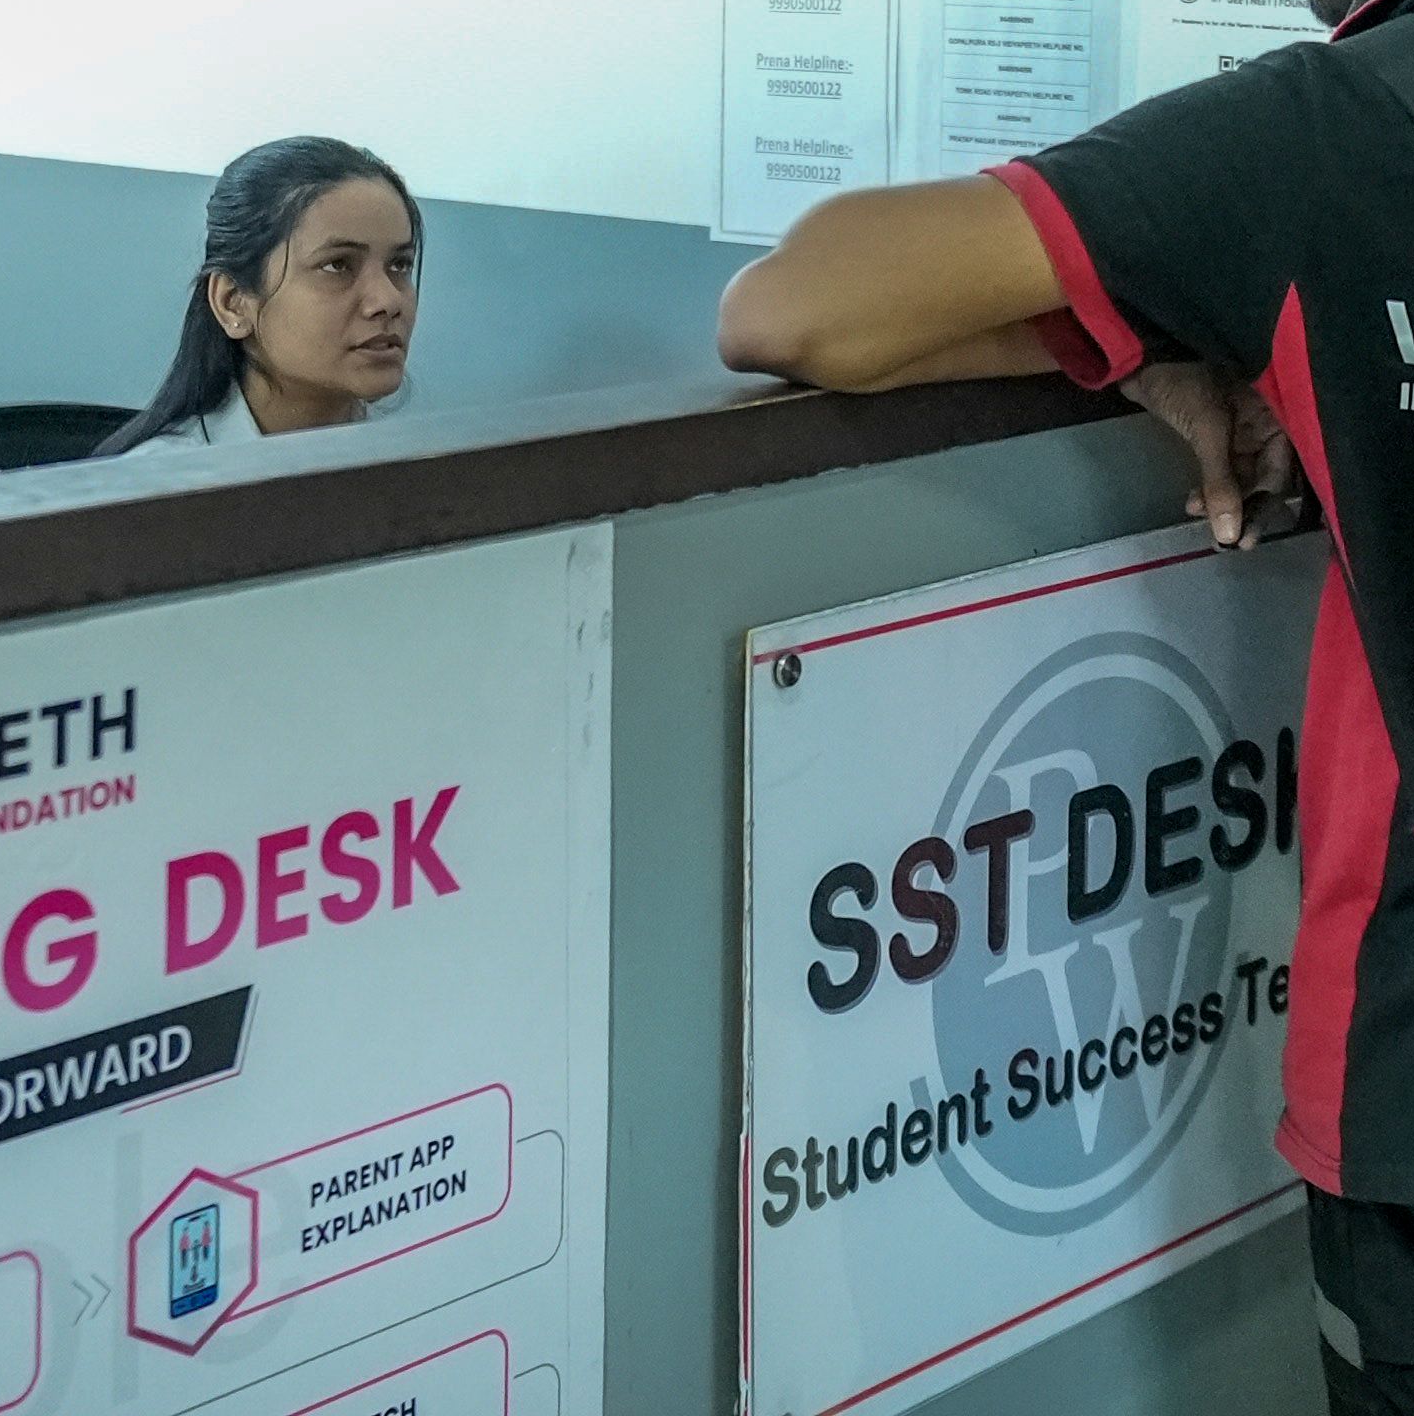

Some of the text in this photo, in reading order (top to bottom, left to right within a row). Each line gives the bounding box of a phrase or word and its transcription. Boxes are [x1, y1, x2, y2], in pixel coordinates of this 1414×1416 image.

[757, 53, 854, 72] Prena Helpline:-
[767, 80, 842, 97] 9990500122
[756, 136, 854, 157] Prena Helpline:-
[766, 163, 842, 182] 9990500122
[164, 785, 461, 977] DESK
[806, 808, 1035, 1015] SST
[762, 1068, 994, 1228] Student
[1007, 990, 1224, 1122] Success
[310, 1134, 455, 1208] PARENT APP
[300, 1169, 467, 1254] EXPLANATION
